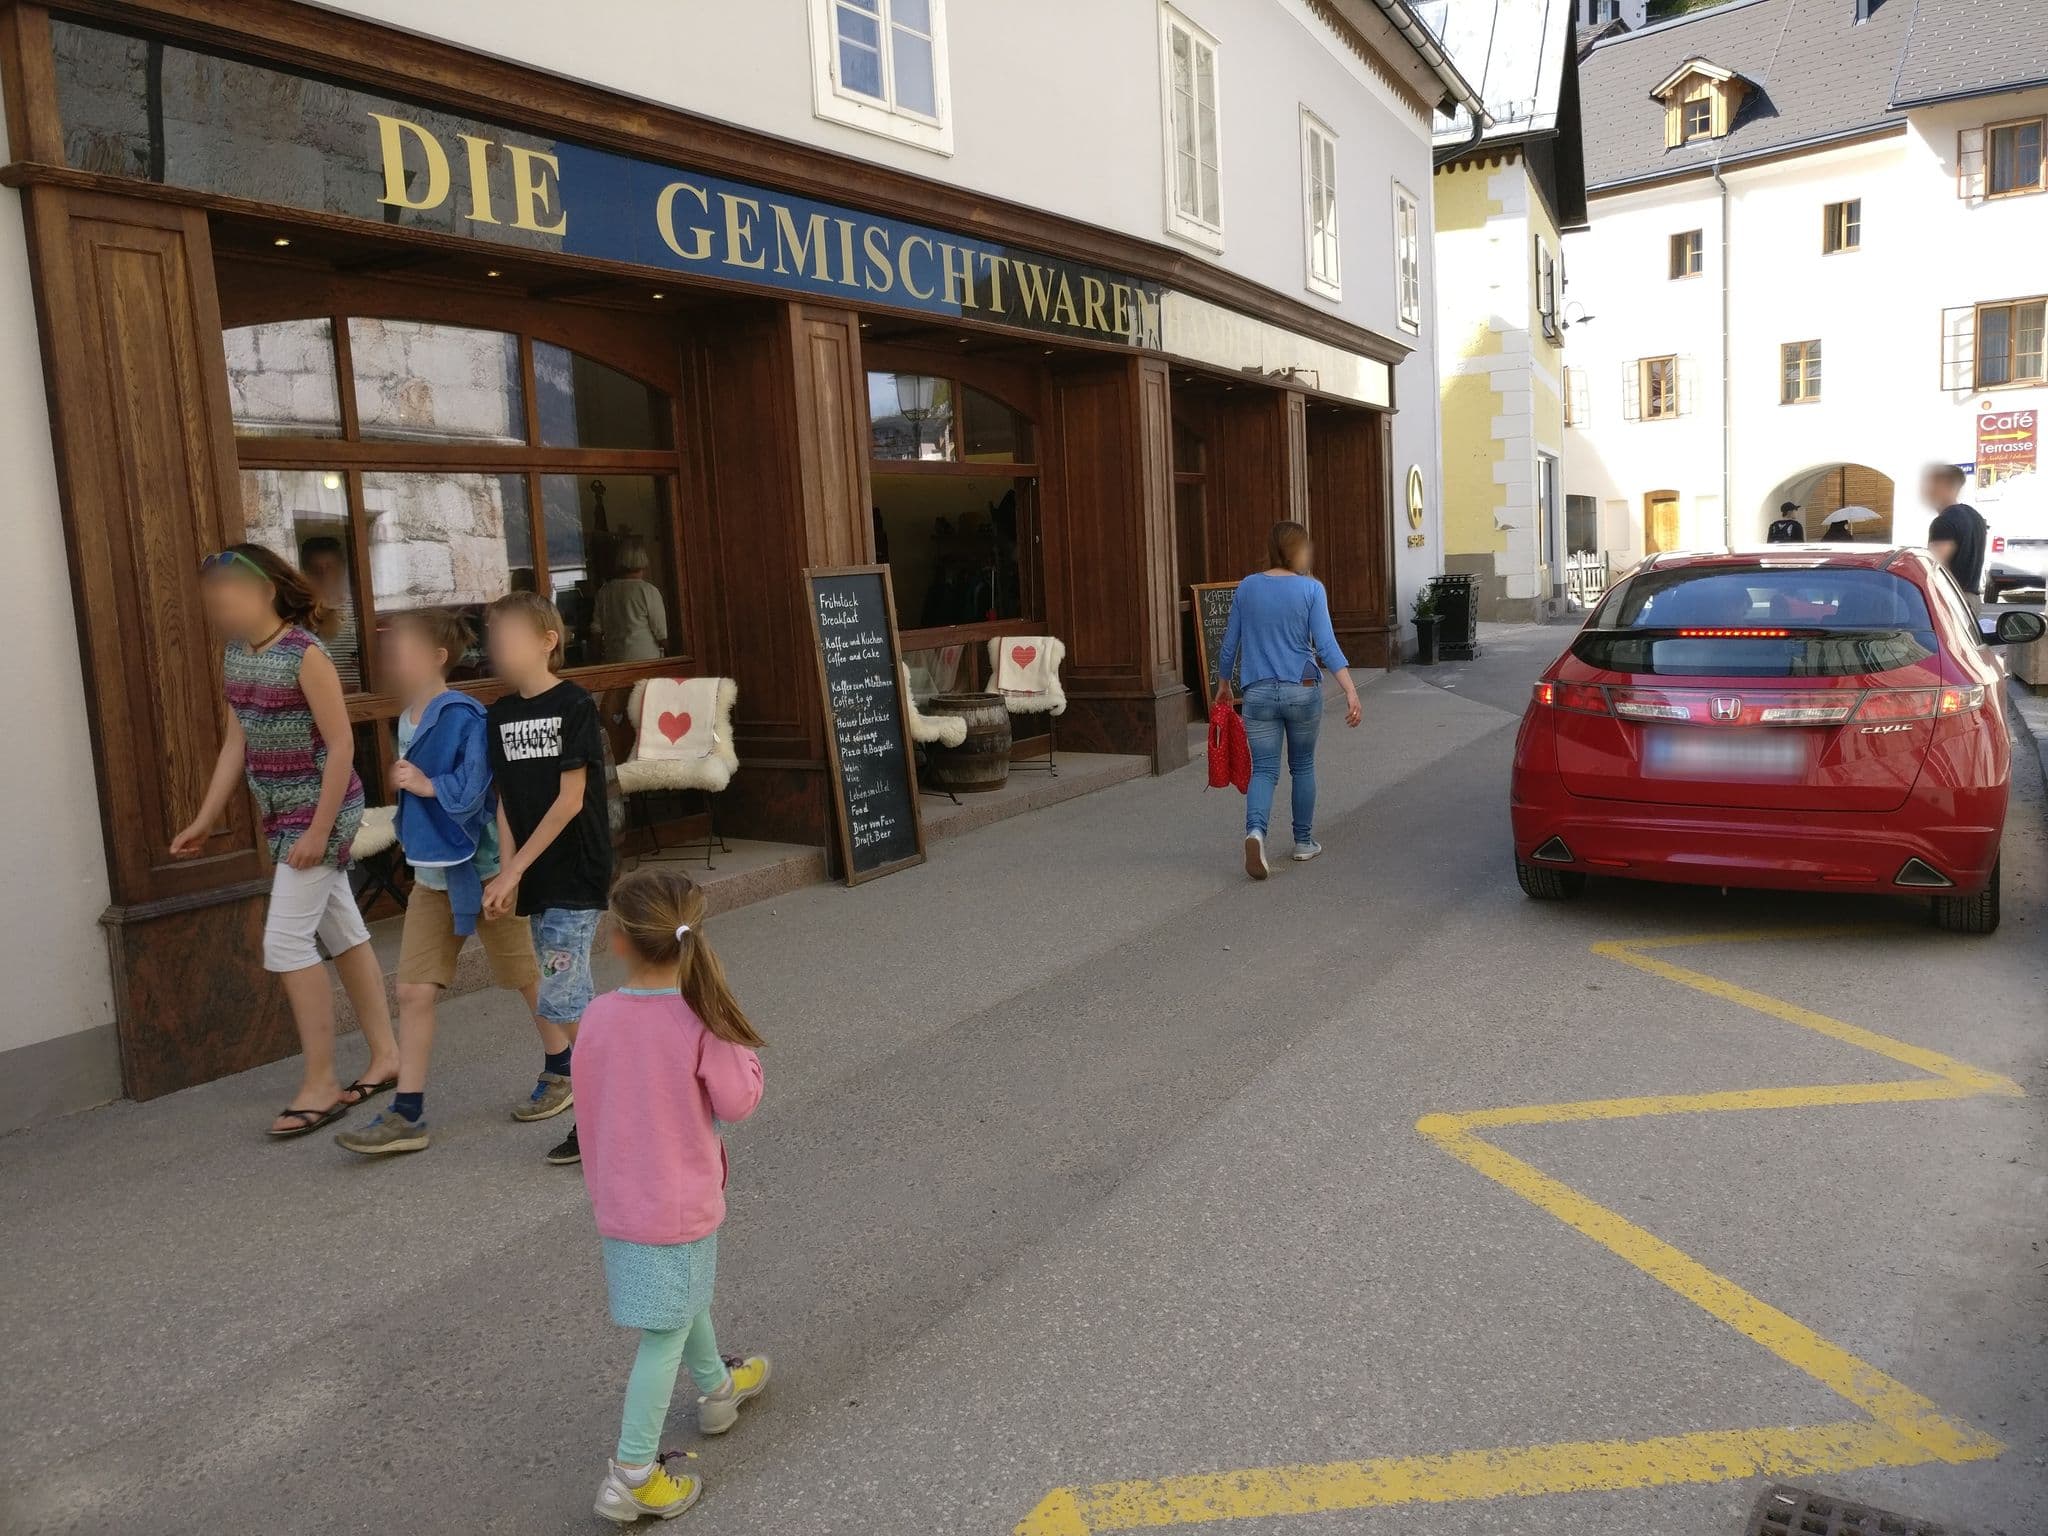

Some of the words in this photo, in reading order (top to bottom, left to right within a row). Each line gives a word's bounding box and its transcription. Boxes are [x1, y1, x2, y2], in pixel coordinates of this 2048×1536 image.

[368, 112, 567, 236] DIE
[1979, 411, 2033, 431] Café
[1979, 440, 2034, 454] Terrasse
[820, 609, 859, 629] Breakfast
[825, 636, 850, 651] Kaffee
[861, 630, 883, 645] Kuchen
[827, 651, 847, 667] Coffee
[849, 651, 861, 661] and
[862, 647, 880, 660] Cake
[833, 695, 855, 708] Coffee
[856, 692, 864, 703] to
[865, 694, 873, 707] go
[1860, 723, 1914, 735] CIVIC
[839, 732, 851, 744] Hot
[841, 746, 861, 759] Pizza
[851, 802, 869, 816] Food
[853, 822, 868, 835] Bier
[855, 832, 875, 848] Draft
[874, 830, 892, 842] Beer
